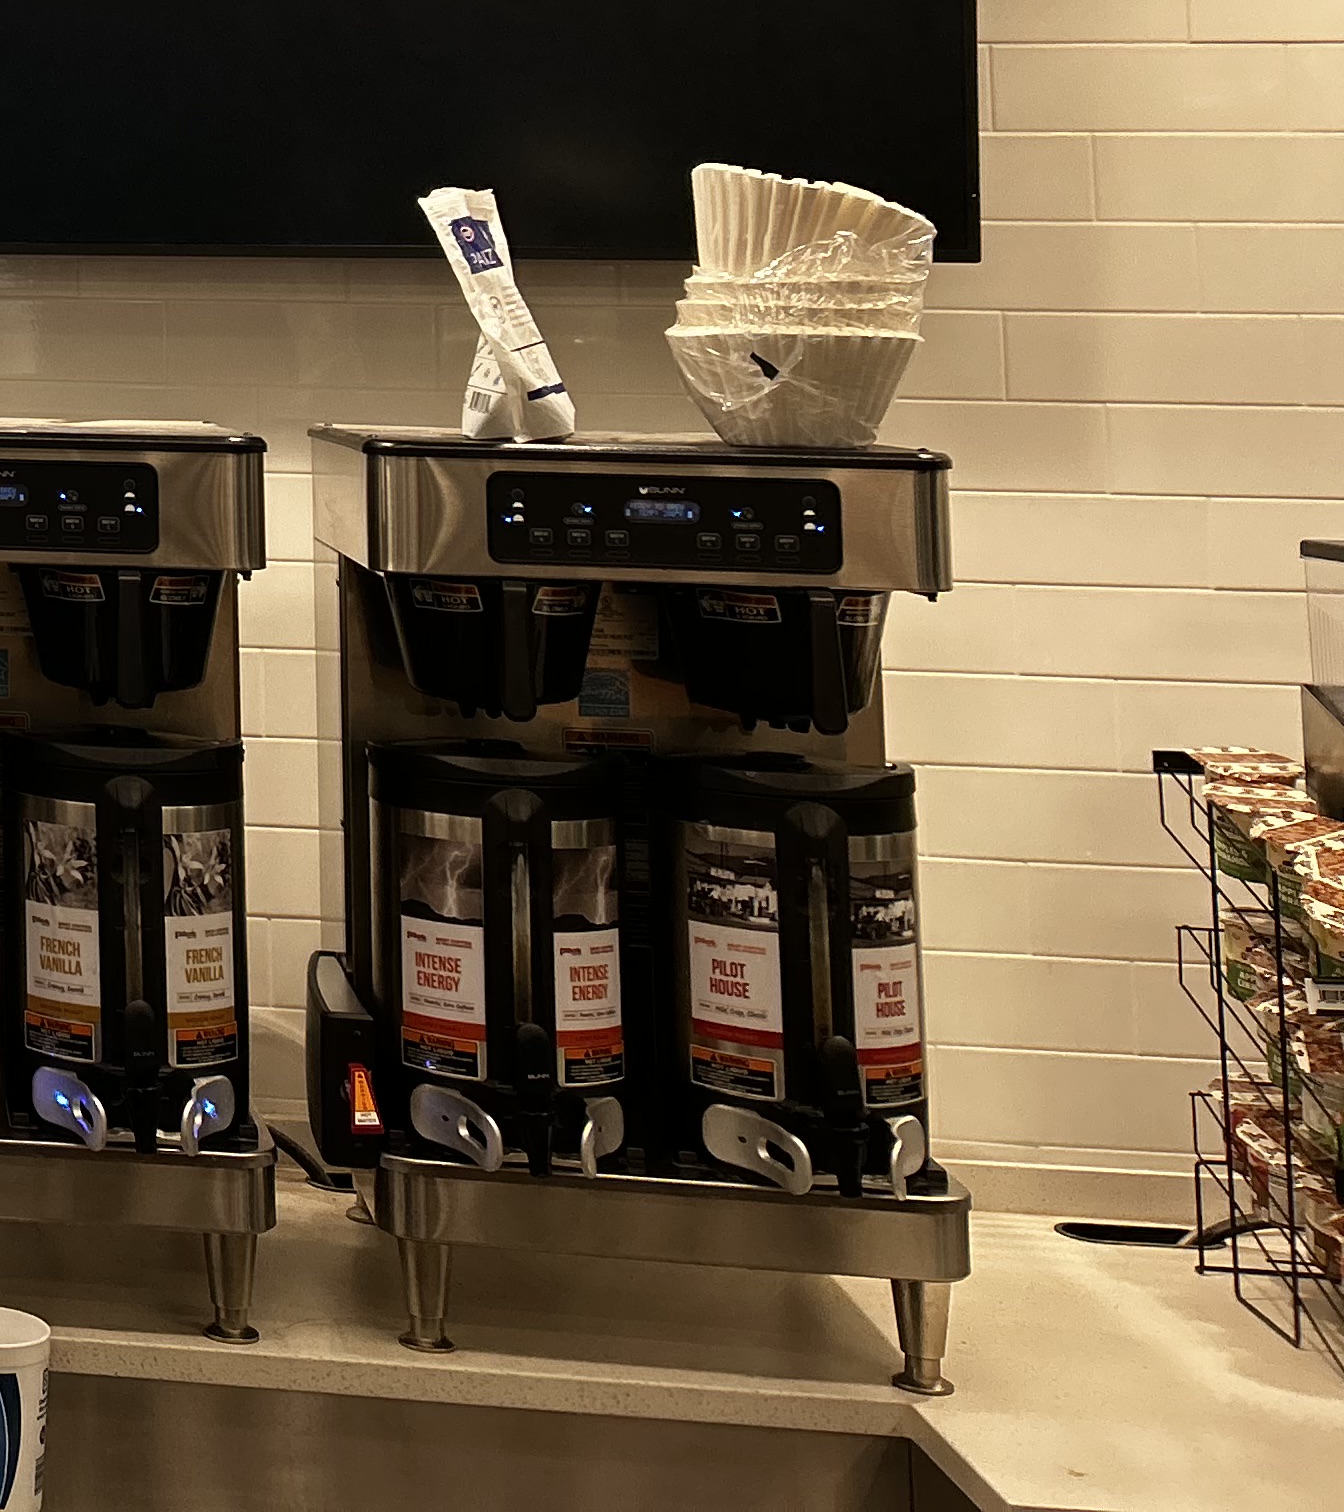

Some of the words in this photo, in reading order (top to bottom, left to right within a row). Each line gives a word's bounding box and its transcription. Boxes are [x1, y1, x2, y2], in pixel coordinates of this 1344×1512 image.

[66, 585, 91, 594] HOT
[441, 595, 468, 605] HOT
[40, 935, 81, 958] FRENCH
[186, 946, 223, 965] FRENCH
[39, 954, 83, 977] VANILLA
[415, 951, 462, 974] INTENSE
[711, 958, 746, 979] PILOT
[184, 964, 224, 984] VANILLA
[416, 971, 460, 992] ENERGY
[569, 963, 609, 982] INTENSE
[572, 983, 609, 1002] ENERGY
[709, 977, 750, 999] HOUSE
[877, 980, 903, 999] PILOT
[875, 1000, 906, 1018] HOUSE
